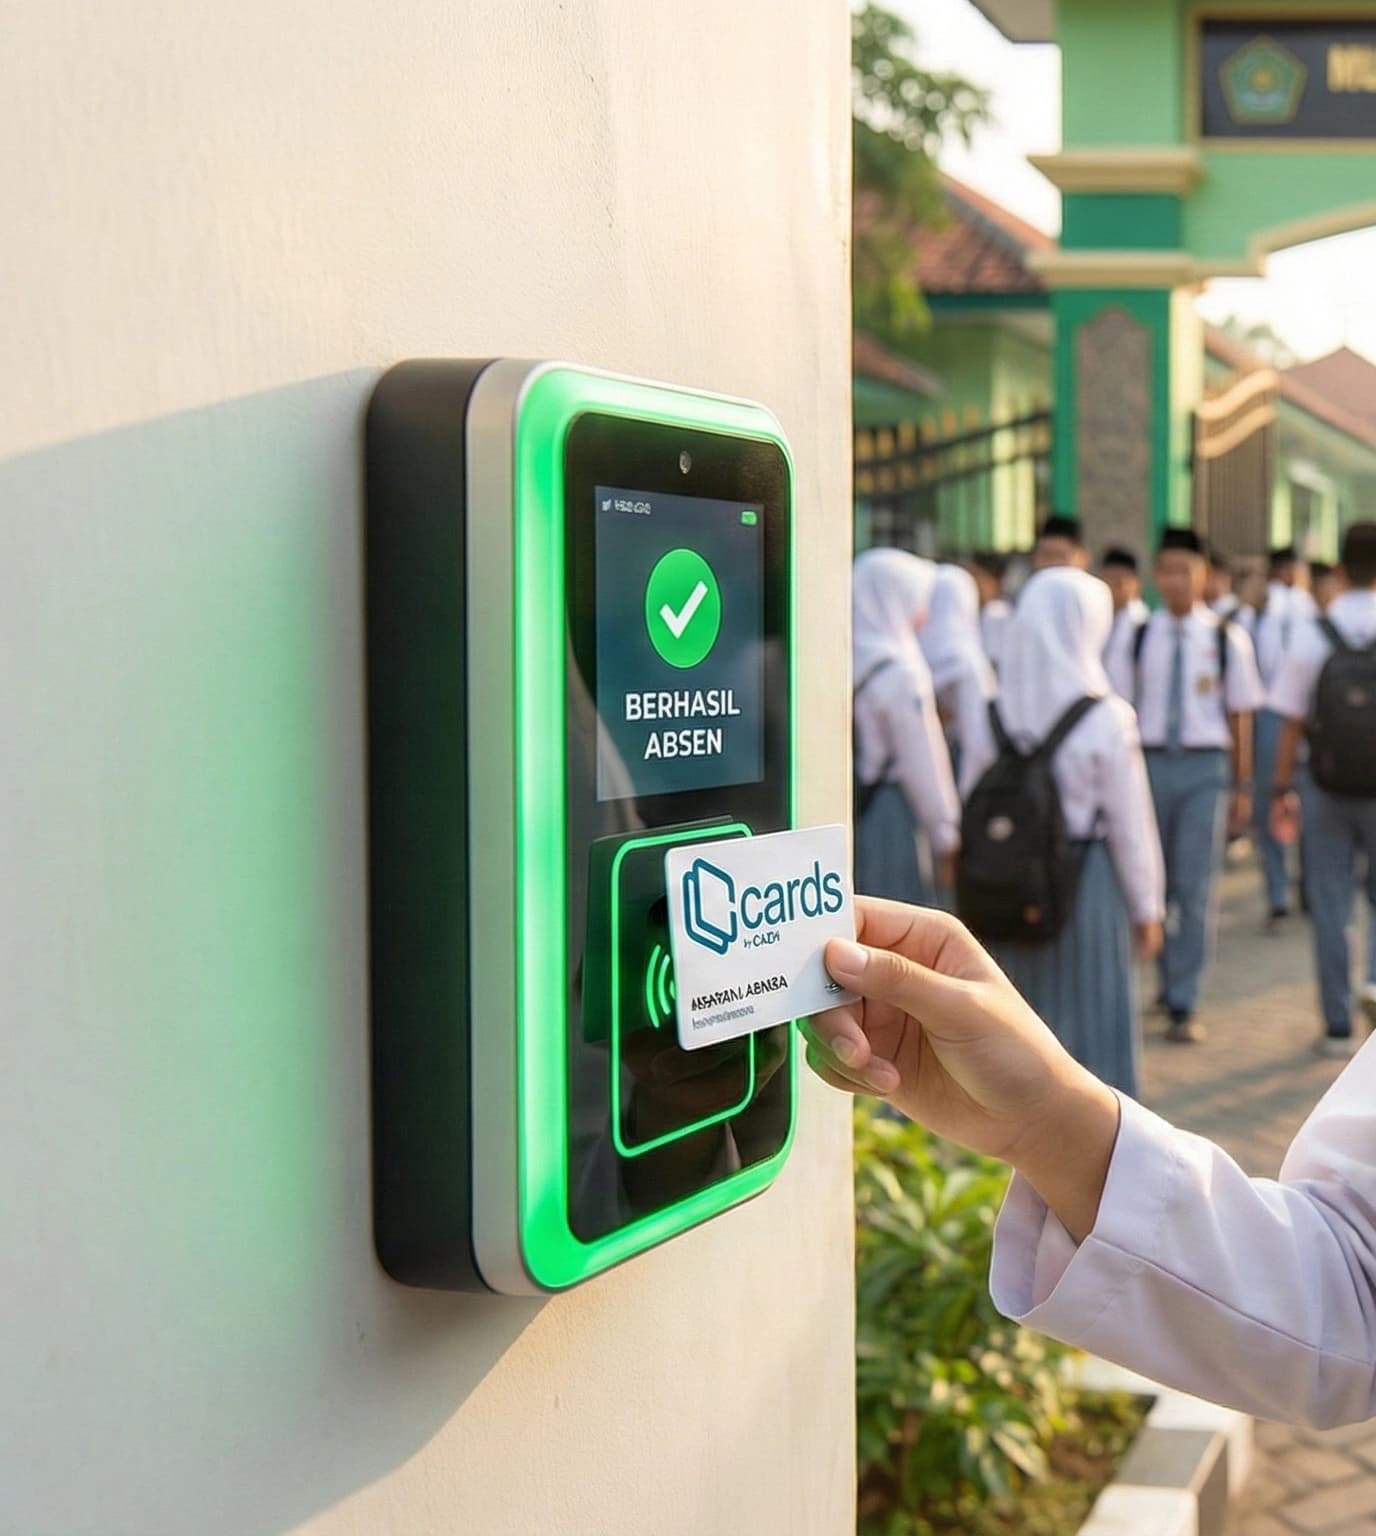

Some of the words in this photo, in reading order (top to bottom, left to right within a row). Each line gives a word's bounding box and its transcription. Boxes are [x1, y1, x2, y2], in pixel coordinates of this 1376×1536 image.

[625, 689, 740, 721] BERHASIL
[644, 728, 723, 760] ABSEN
[740, 861, 844, 930] cards
